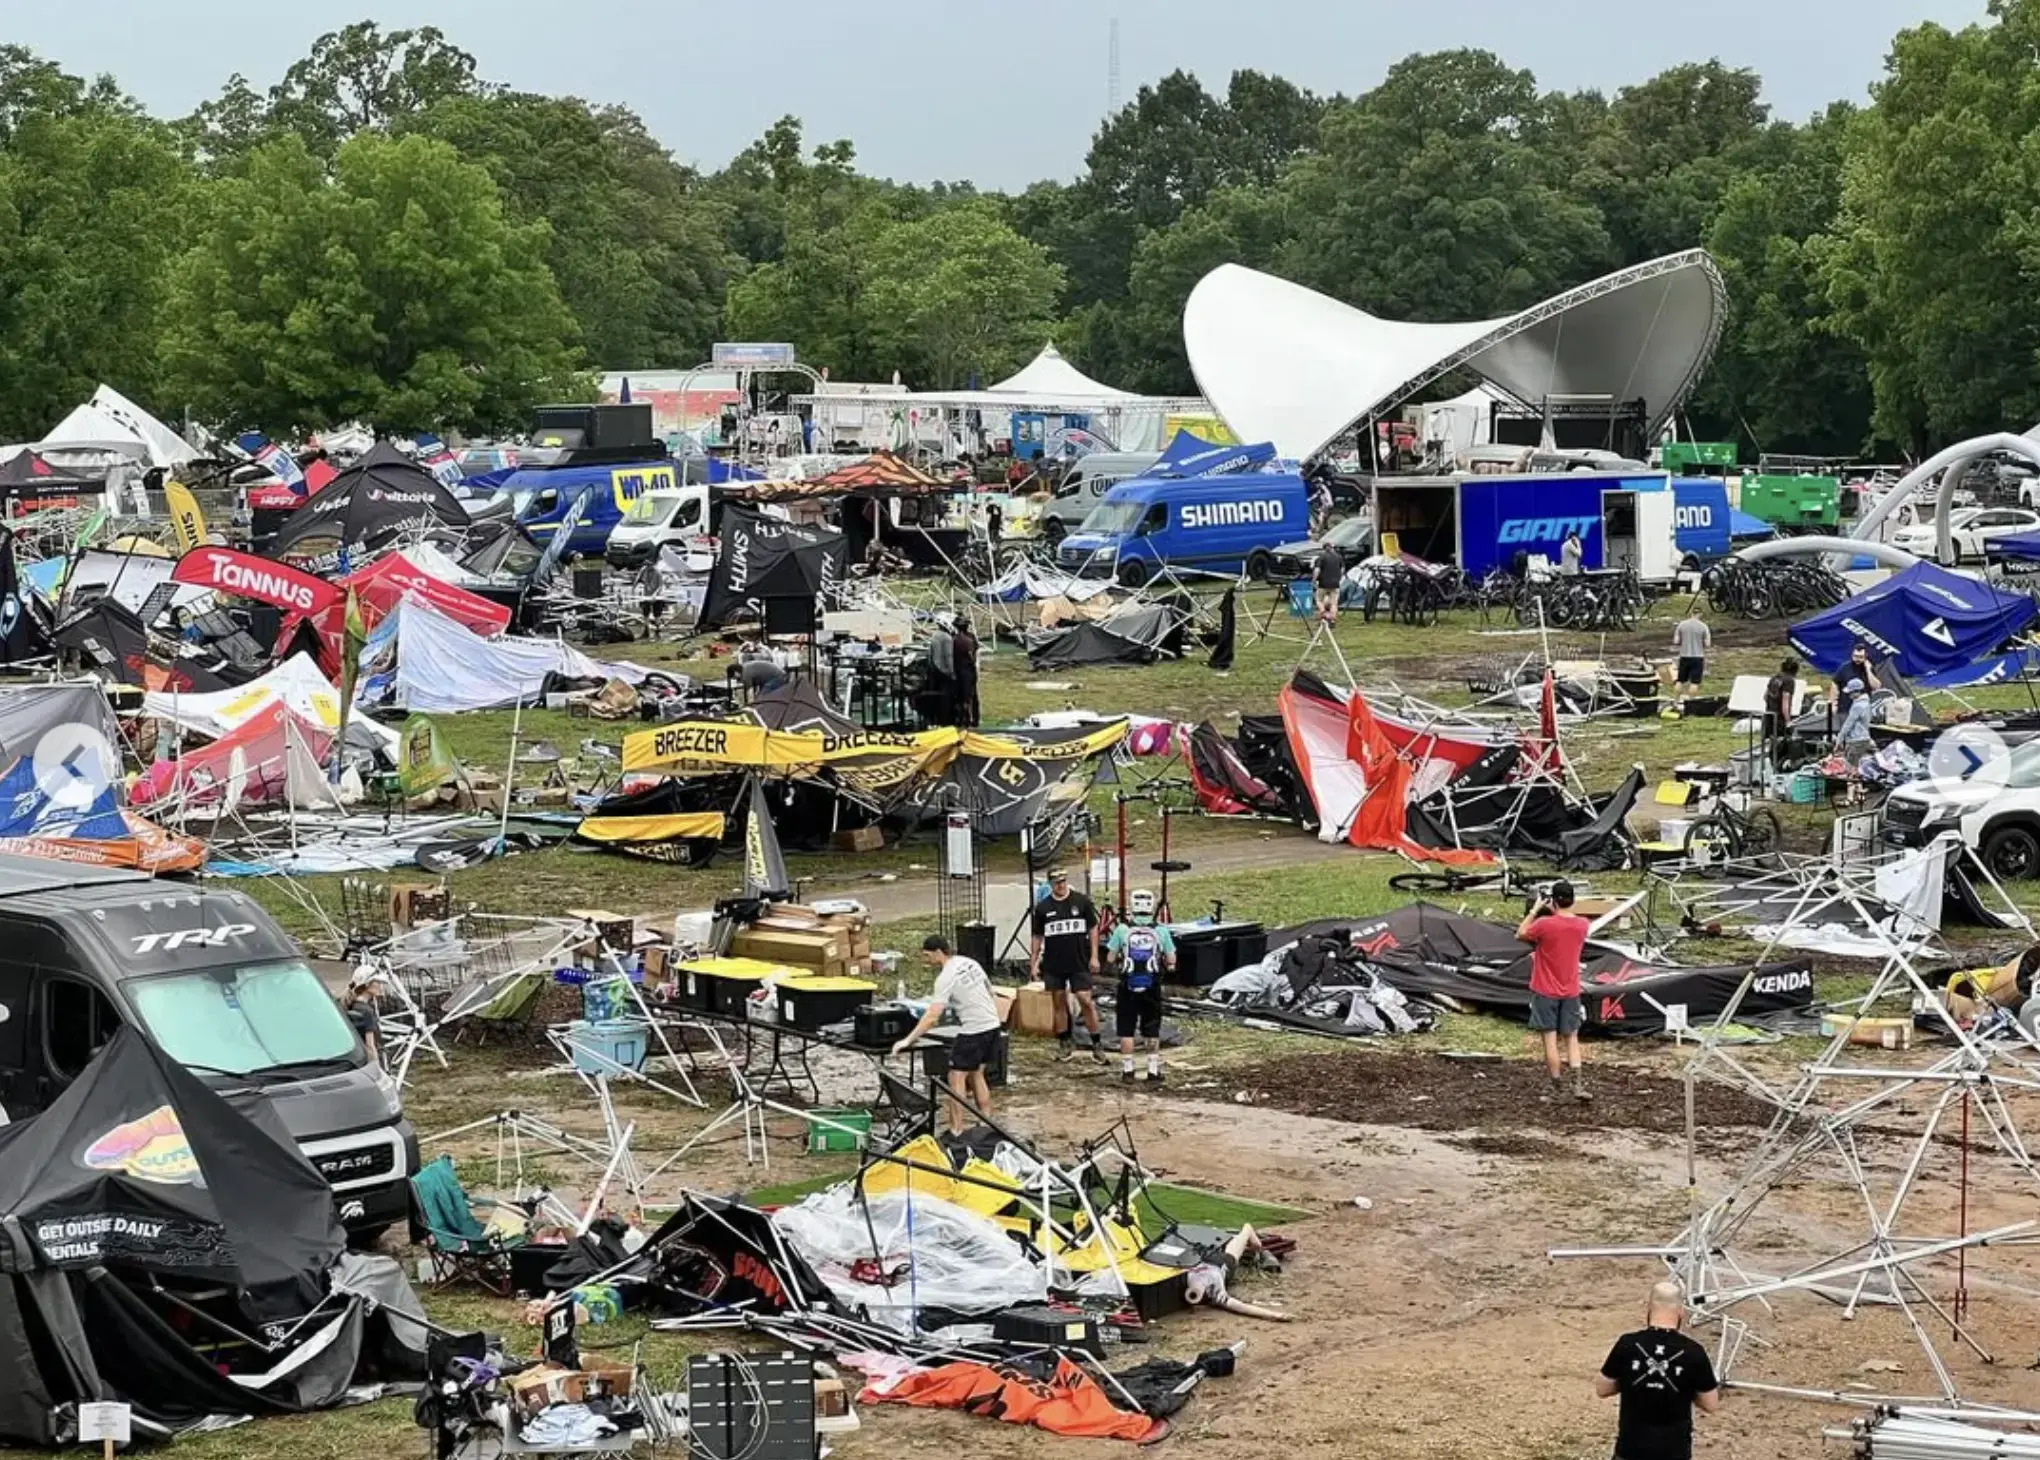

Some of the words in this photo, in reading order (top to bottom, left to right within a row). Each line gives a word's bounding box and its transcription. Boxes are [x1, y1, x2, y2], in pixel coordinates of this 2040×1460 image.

[1181, 500, 1284, 528] SHIMANO
[1498, 516, 1600, 543] GIANT
[728, 529, 749, 592] SMITH
[654, 728, 728, 756] BREEZER
[131, 923, 257, 954] TRP
[1752, 969, 1811, 993] KENDA
[321, 1155, 372, 1172] RAM
[38, 1225, 64, 1241] GET
[114, 1217, 163, 1238] DAILY
